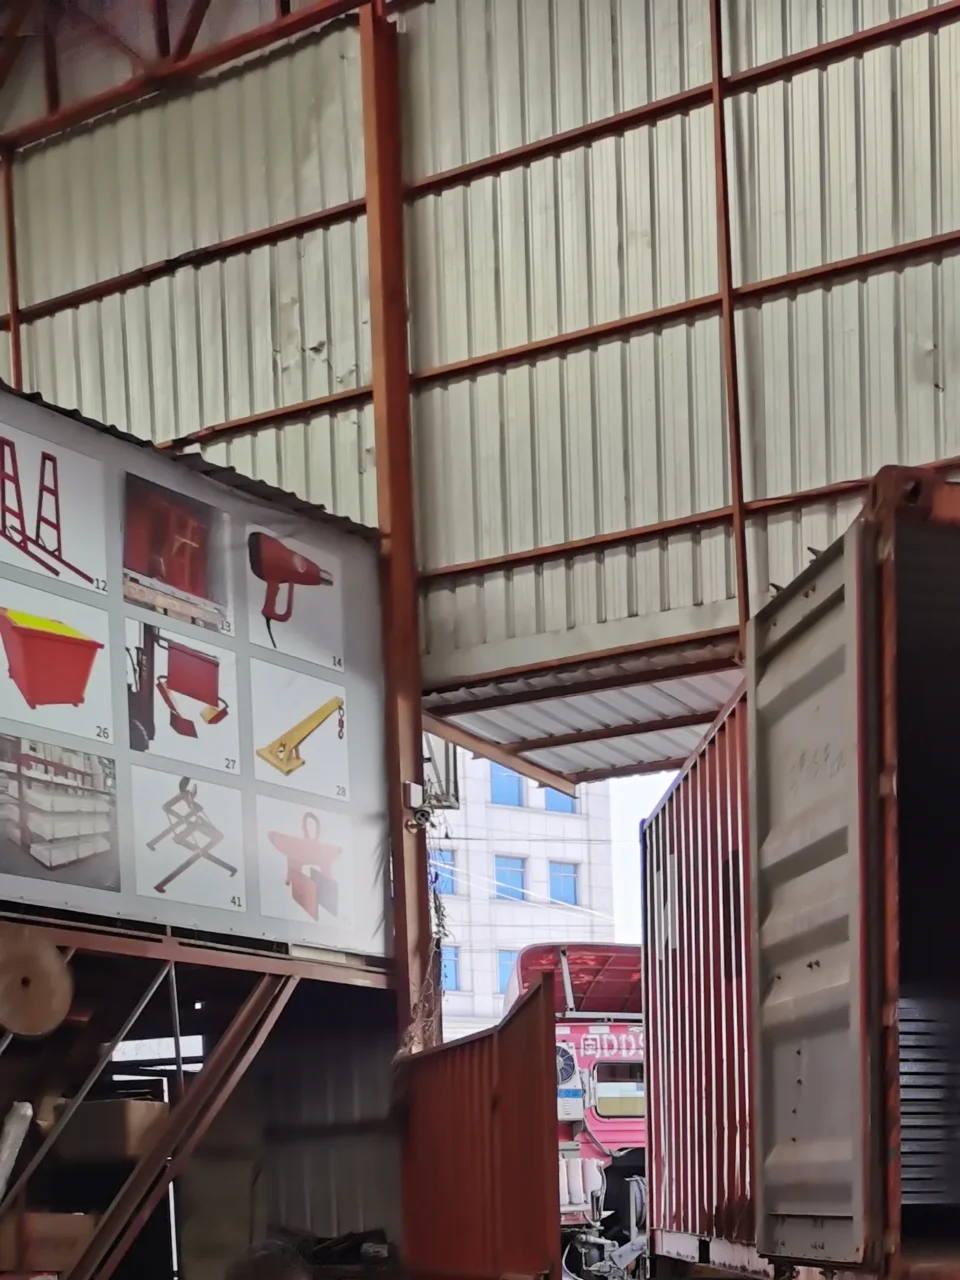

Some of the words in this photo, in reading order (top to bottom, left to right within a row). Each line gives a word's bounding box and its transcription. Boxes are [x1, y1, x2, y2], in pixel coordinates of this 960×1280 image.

[95, 578, 108, 592] 12
[220, 619, 232, 632] 13
[332, 655, 342, 668] 14
[96, 726, 109, 740] 26
[225, 758, 236, 770] 27
[336, 785, 346, 797] 28
[230, 896, 242, 908] 41
